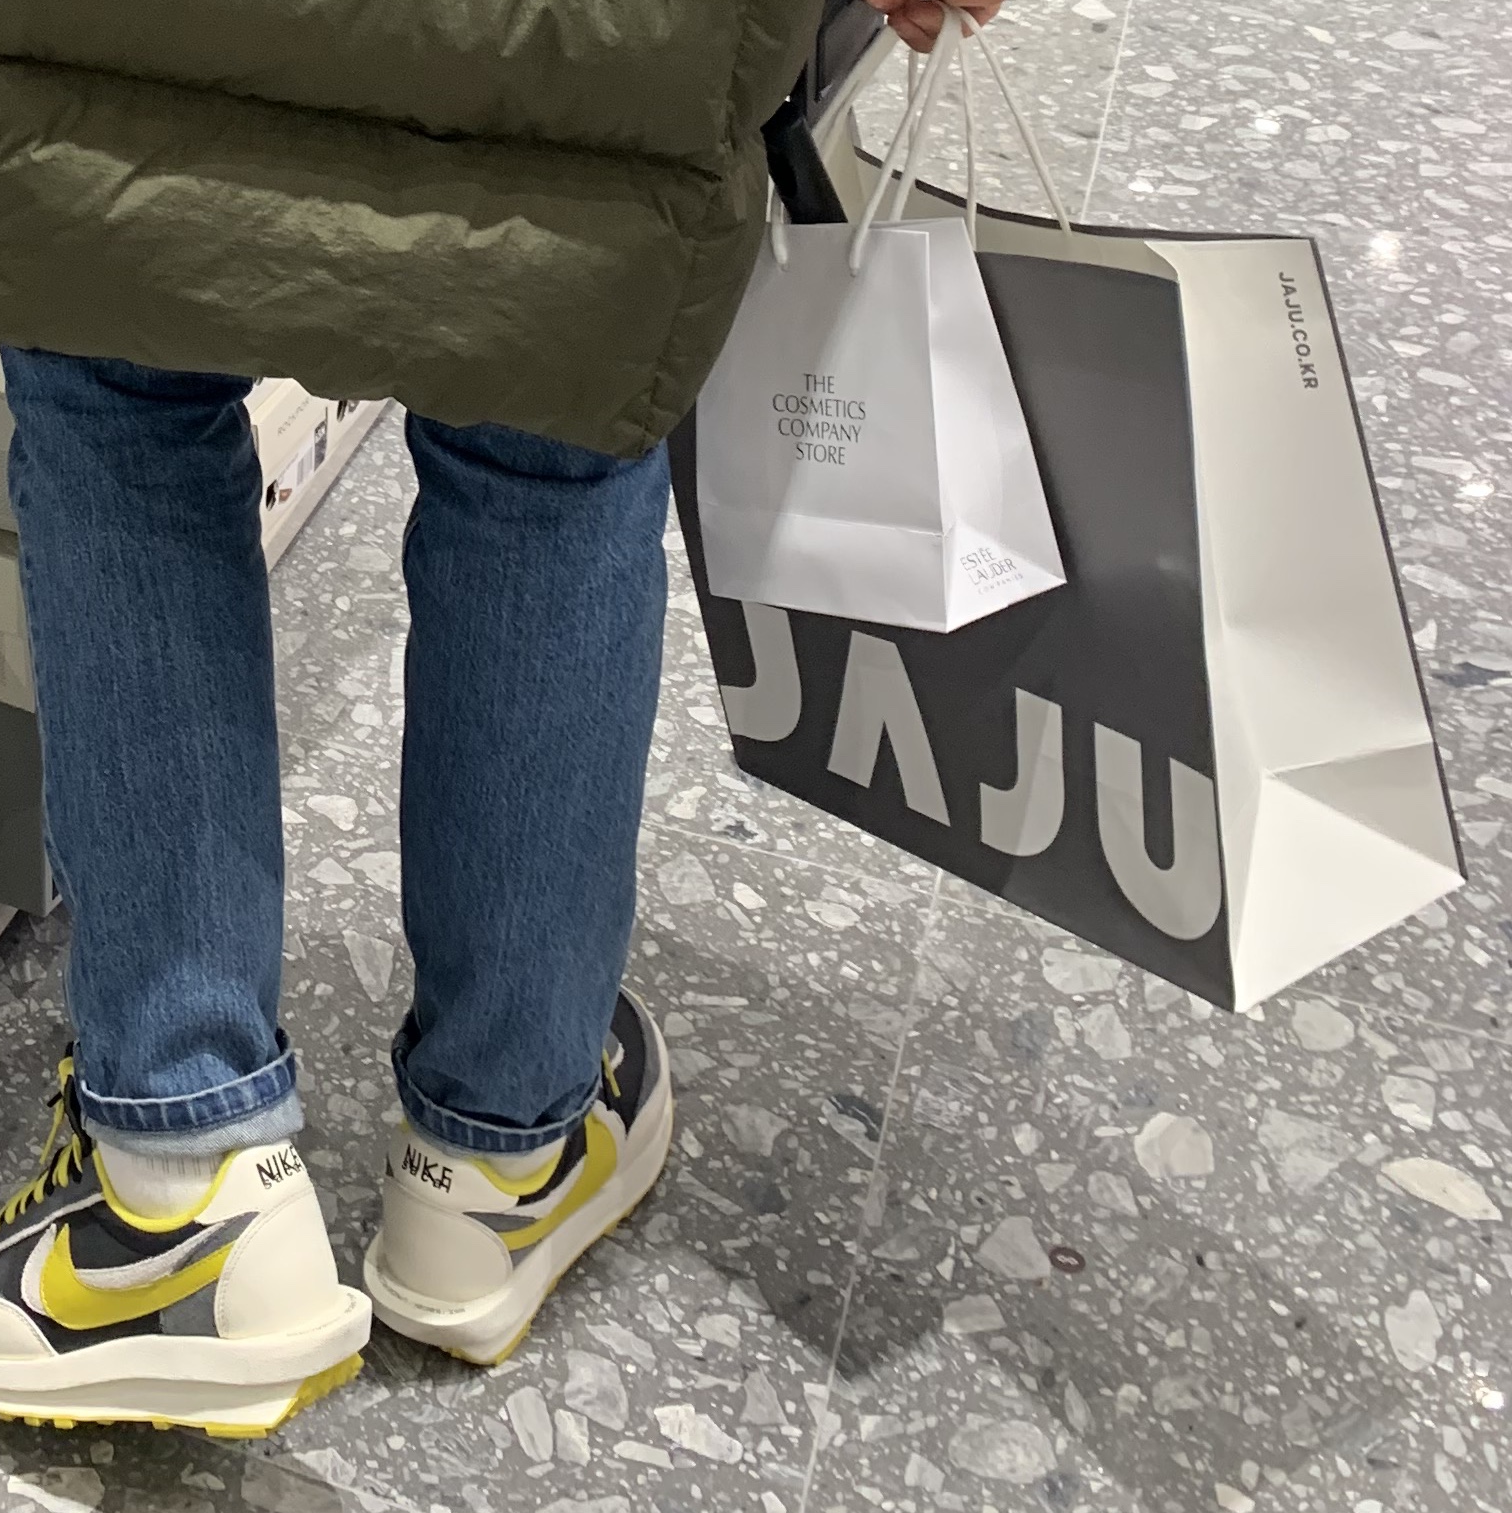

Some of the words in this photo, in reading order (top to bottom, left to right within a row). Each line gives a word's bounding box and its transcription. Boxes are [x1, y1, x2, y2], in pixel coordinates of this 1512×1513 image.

[1278, 271, 1319, 390] JAJU.CO.KR
[803, 373, 835, 394] THE
[772, 393, 866, 421] COSMETICS
[778, 417, 861, 443] COMPANY
[795, 441, 846, 466] STORE
[719, 601, 1223, 941] JAJU
[404, 1143, 453, 1190] NIKE
